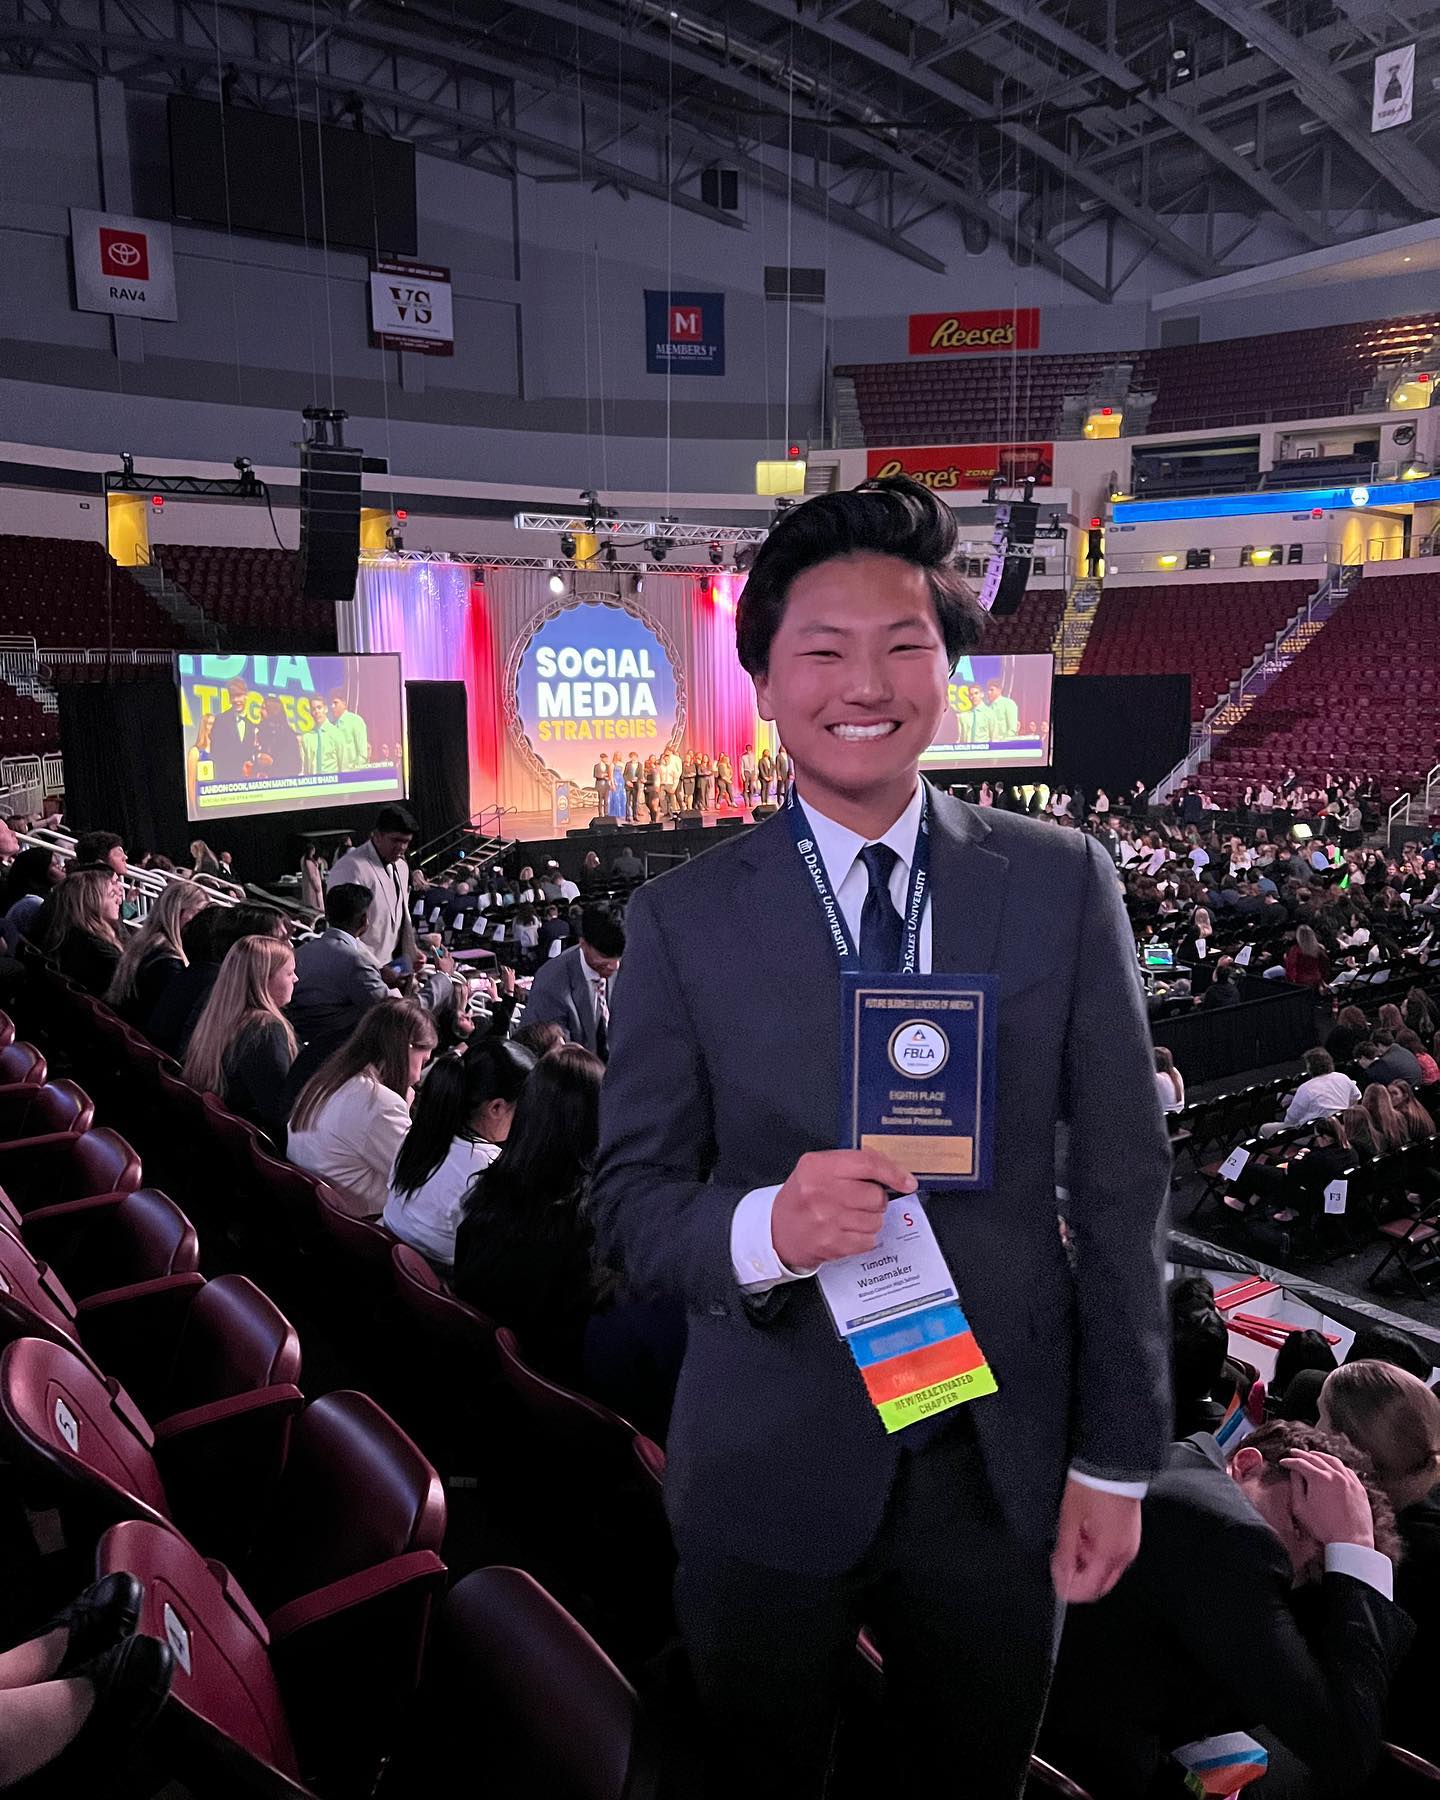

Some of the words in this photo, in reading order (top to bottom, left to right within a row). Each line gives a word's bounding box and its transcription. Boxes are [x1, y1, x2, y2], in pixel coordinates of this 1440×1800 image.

[109, 286, 146, 302] RAV4
[389, 286, 432, 325] VS
[675, 312, 697, 335] M
[930, 319, 1016, 348] Reese's
[656, 343, 707, 356] MEMBERS
[964, 469, 996, 478] ZONE
[536, 646, 656, 678] SOCIAL
[537, 682, 658, 718] MEDIA
[538, 718, 658, 742] STRATEGIES
[907, 869, 927, 931] UNIVERSITY
[822, 896, 849, 957] UNIVERSITY
[903, 1048, 935, 1059] FBLA
[920, 1091, 946, 1101] PLACE
[1227, 1158, 1237, 1166] F2
[1329, 1193, 1341, 1201] F3
[903, 1213, 914, 1227] S
[861, 1254, 899, 1272] Timothy
[857, 1265, 912, 1288] Wanamaker
[894, 1374, 974, 1411] NEW/REACTIVATED
[919, 1392, 959, 1415] CHAPTER
